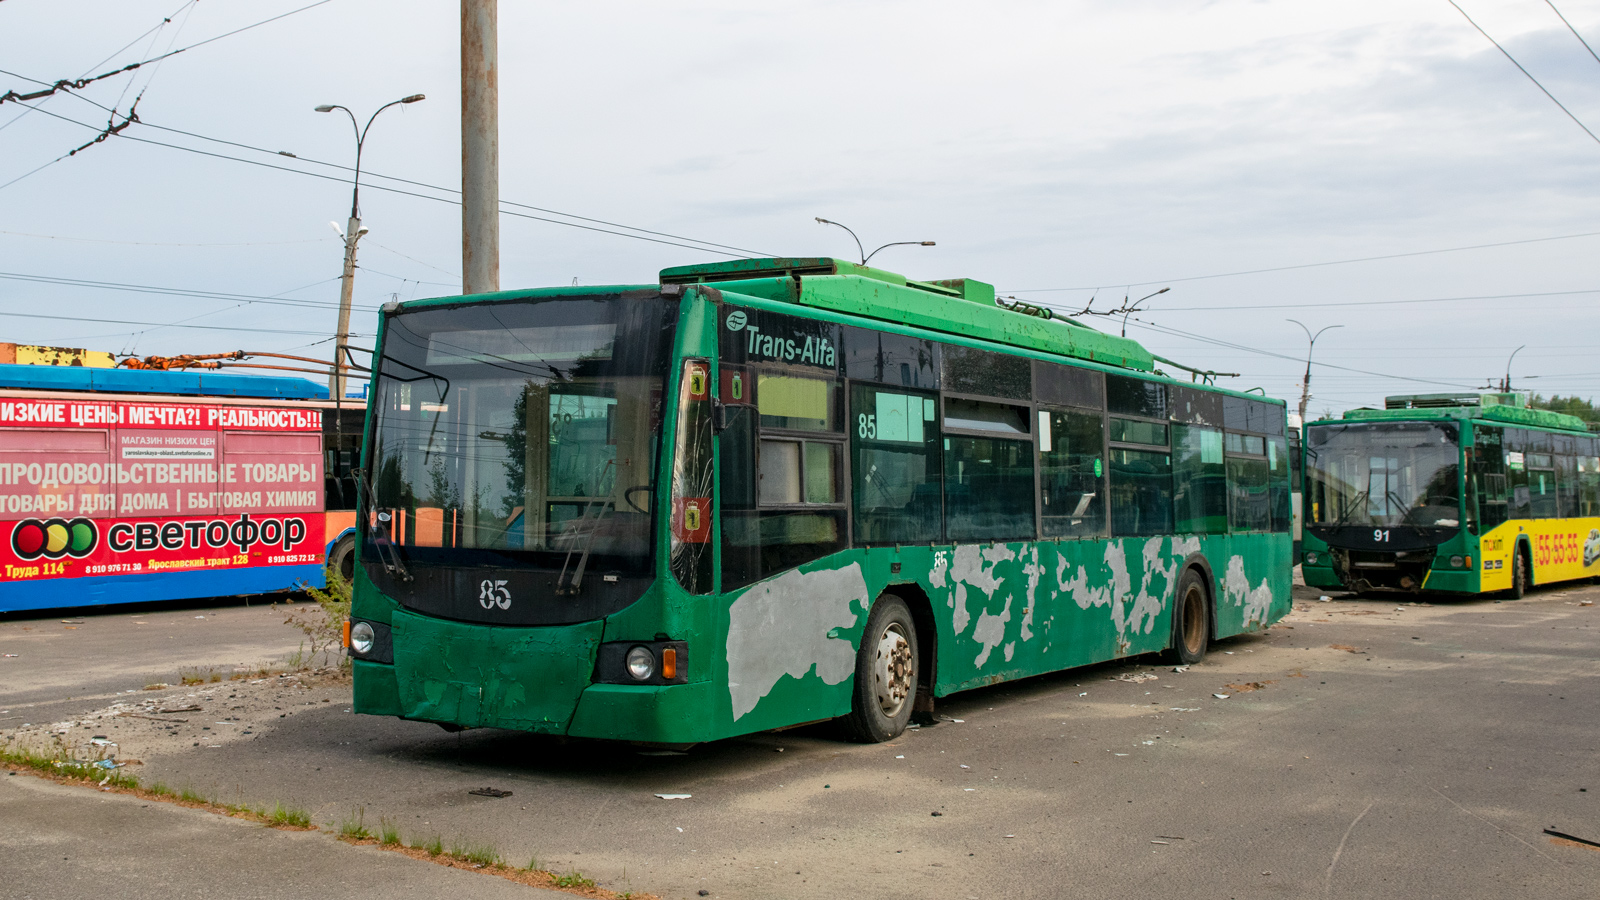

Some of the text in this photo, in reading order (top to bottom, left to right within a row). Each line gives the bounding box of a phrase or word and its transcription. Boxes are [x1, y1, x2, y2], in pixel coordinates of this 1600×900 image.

[747, 326, 835, 367] Trans-Alfa
[71, 404, 124, 426] ЦЕНЫ
[129, 406, 200, 426] МЕЧТА?!
[208, 408, 323, 428] РЕАЛЬНОСТЬ!!!
[858, 413, 876, 439] 85
[121, 436, 215, 446] МАГАЗИН НИЗКИХ ЦЕН
[0, 462, 316, 488] ПРОДОВОЛЬСТВЕННЫЕ ТОВАРЫ
[0, 490, 316, 514] ТОВАРЫ ДЛЯ ДОМА БЫТОВАЯ ХИМИЯ
[108, 513, 306, 553] светофор
[1373, 529, 1390, 542] 91
[5, 563, 64, 579] Труда 114
[85, 562, 141, 574] 8 910 976 71 30
[148, 555, 248, 570] Ярославский тракт 128
[934, 551, 948, 569] 85
[479, 579, 512, 610] 85
